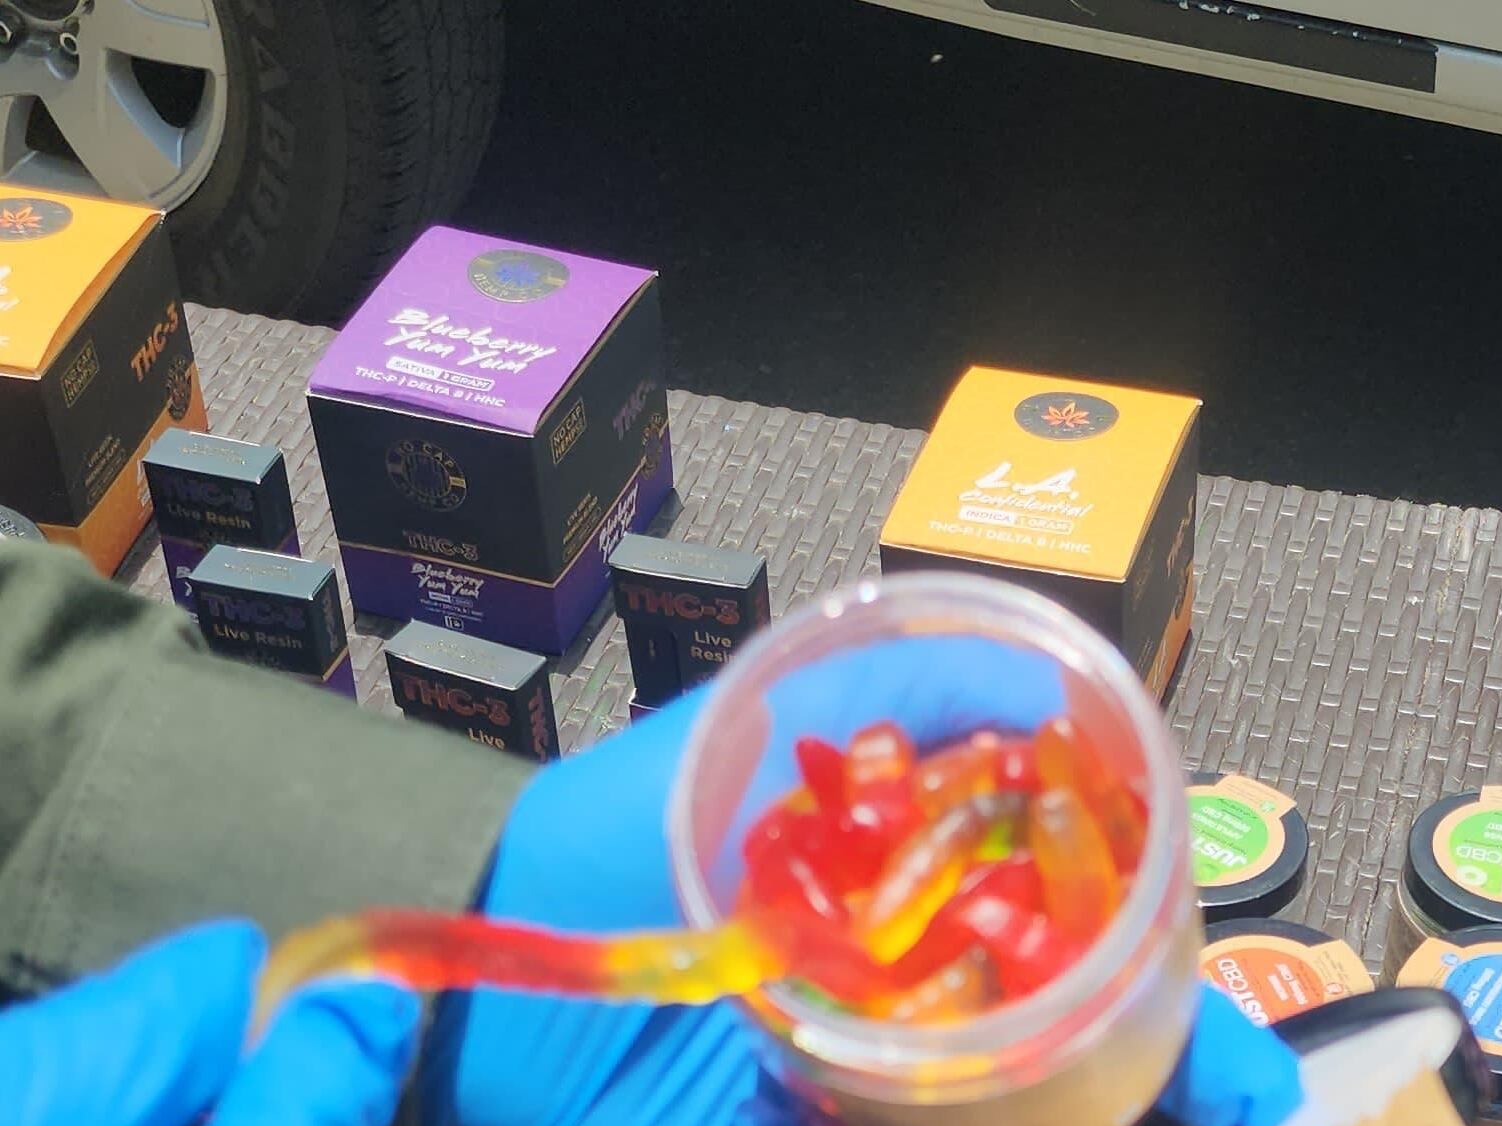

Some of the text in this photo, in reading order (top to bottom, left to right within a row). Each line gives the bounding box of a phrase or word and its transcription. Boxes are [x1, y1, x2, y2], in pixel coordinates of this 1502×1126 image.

[384, 326, 531, 375] Yum Yum
[386, 308, 558, 361] Blueberry
[957, 488, 1095, 518] Confidential
[619, 583, 742, 626] THC-3
[213, 623, 303, 650] Live Resin
[693, 631, 733, 648] Live
[394, 674, 512, 728] THC-3
[467, 727, 506, 750] Live
